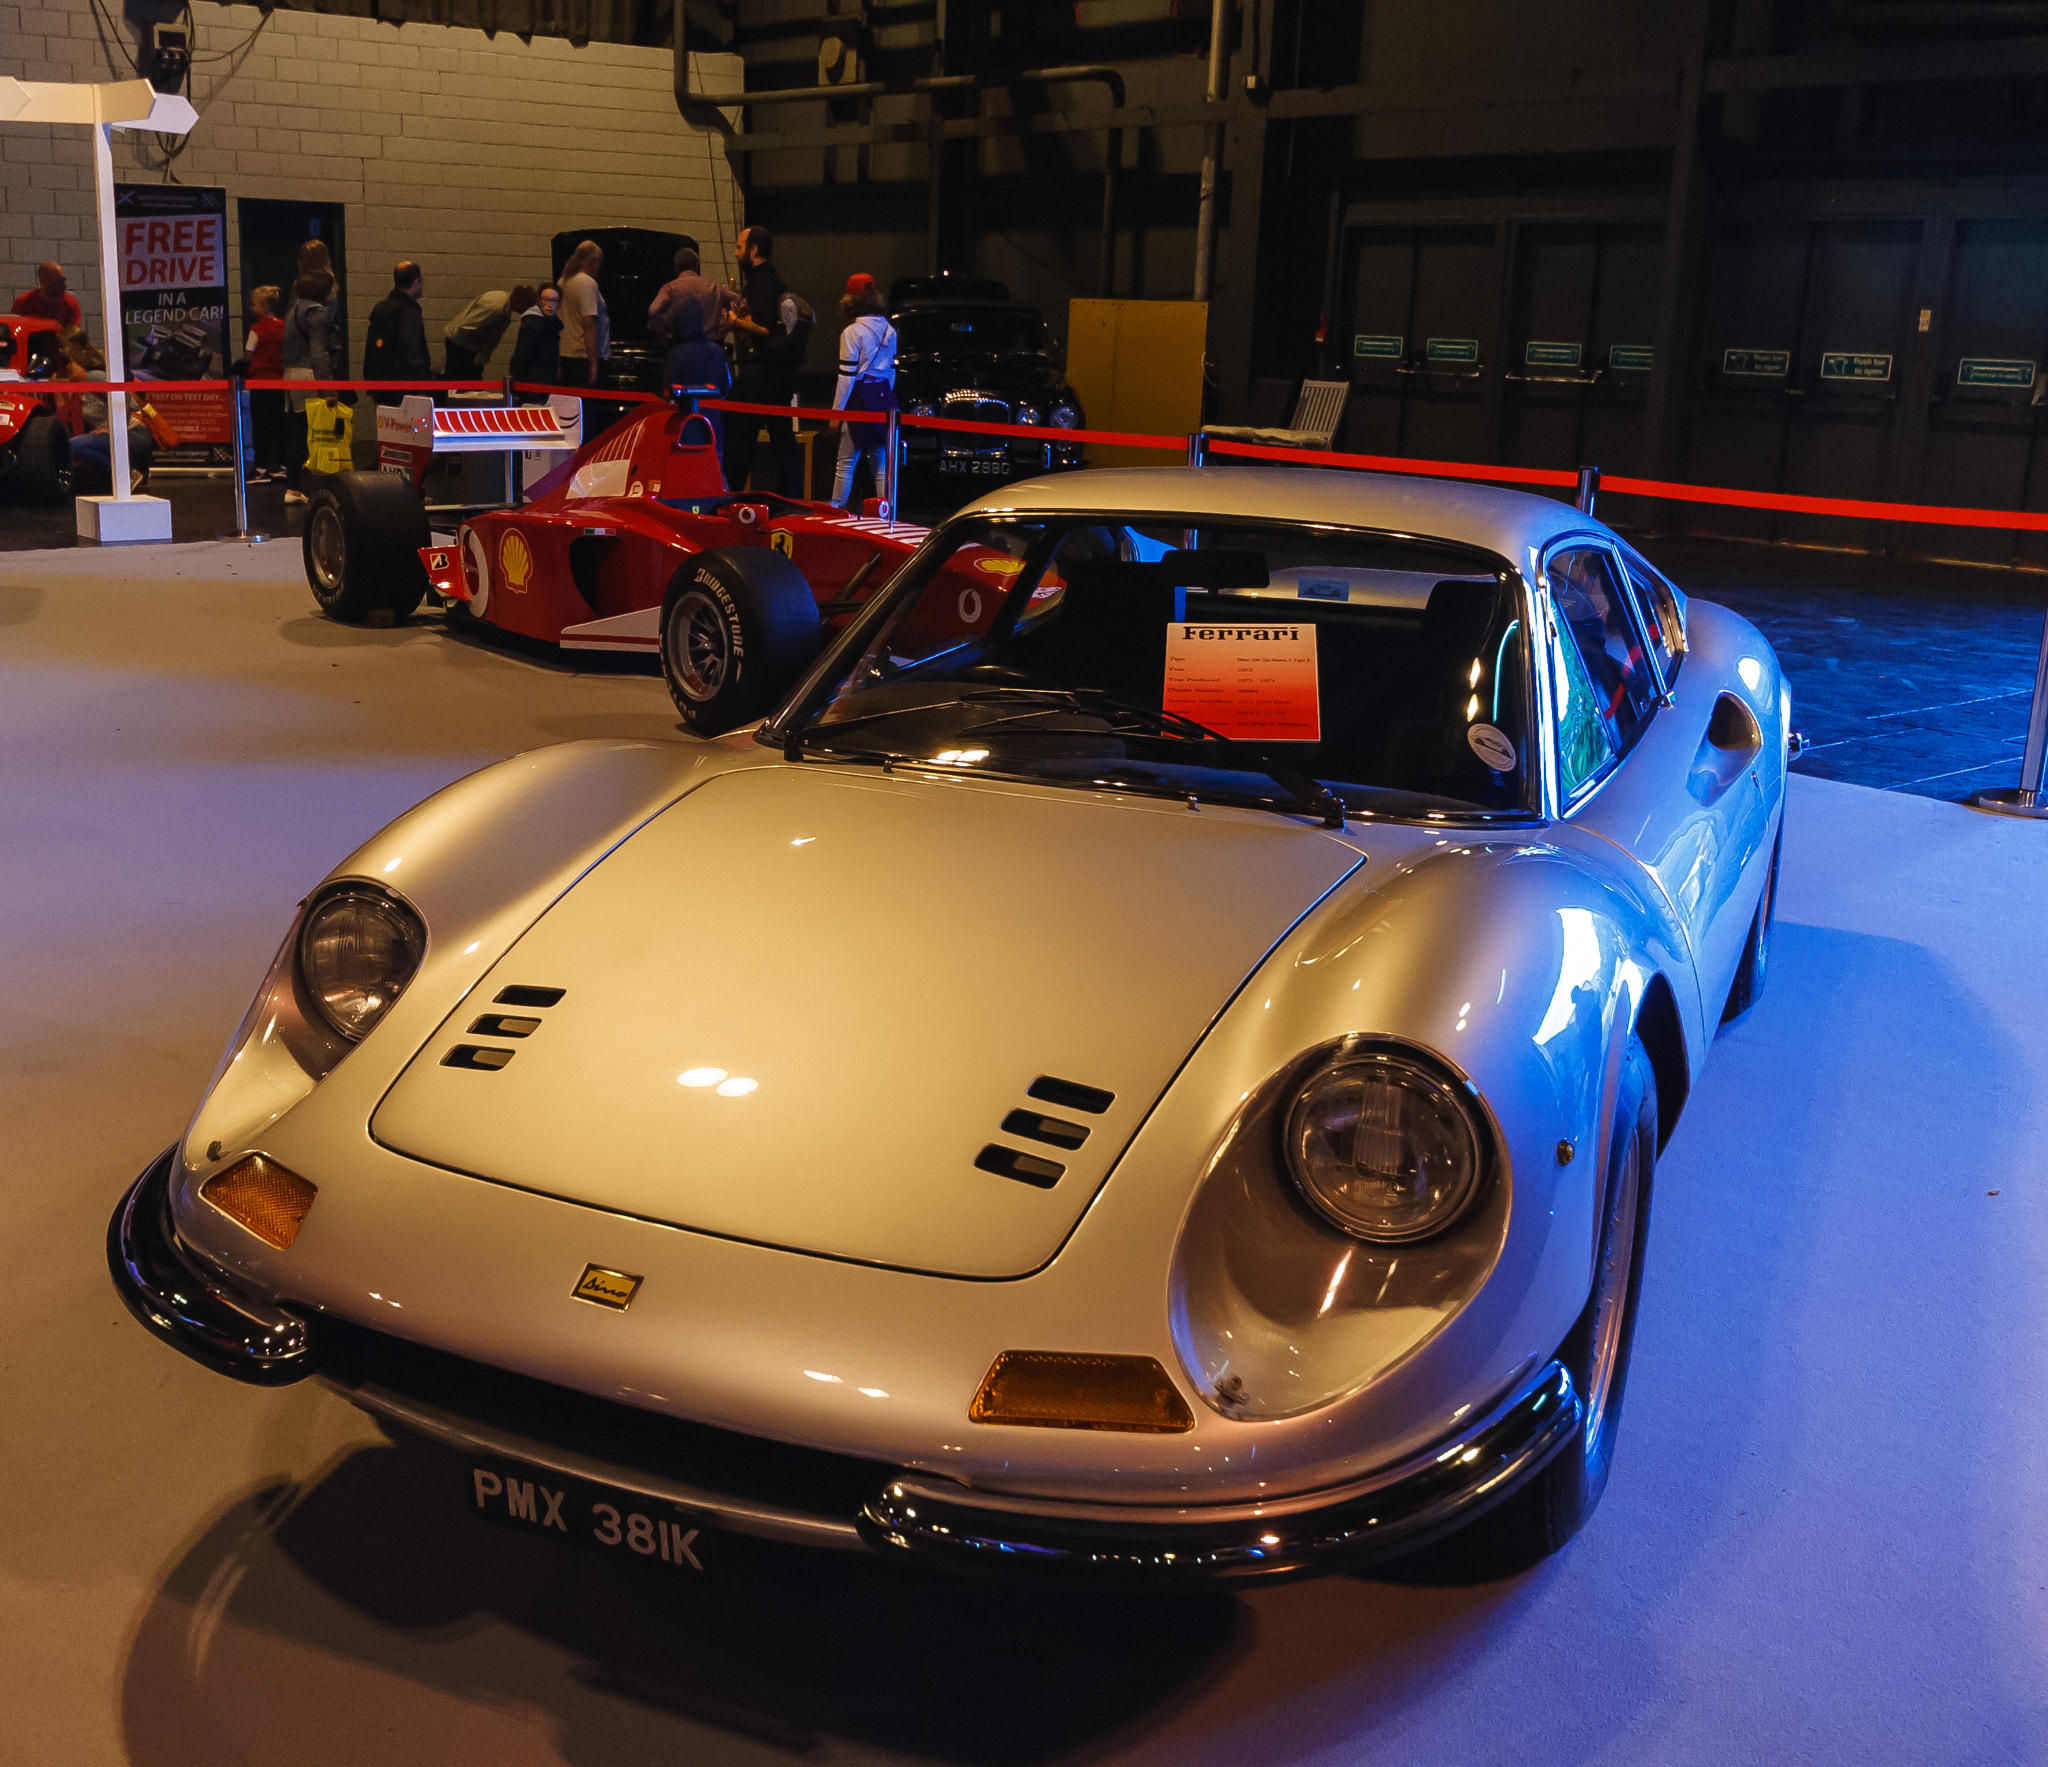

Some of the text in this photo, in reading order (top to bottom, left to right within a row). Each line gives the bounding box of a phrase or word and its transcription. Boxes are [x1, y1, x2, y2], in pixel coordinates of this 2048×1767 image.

[125, 219, 216, 256] FREE
[126, 255, 215, 286] DRIVE
[158, 291, 187, 306] IN A
[125, 305, 224, 325] LEGEND CAR!
[1853, 357, 1872, 366] Push
[940, 460, 967, 473] AHX
[693, 567, 744, 657] BRIDGESTONE
[1181, 626, 1300, 641] Ferrari
[581, 1276, 628, 1298] Dino
[473, 1467, 704, 1572] PMX 381K
